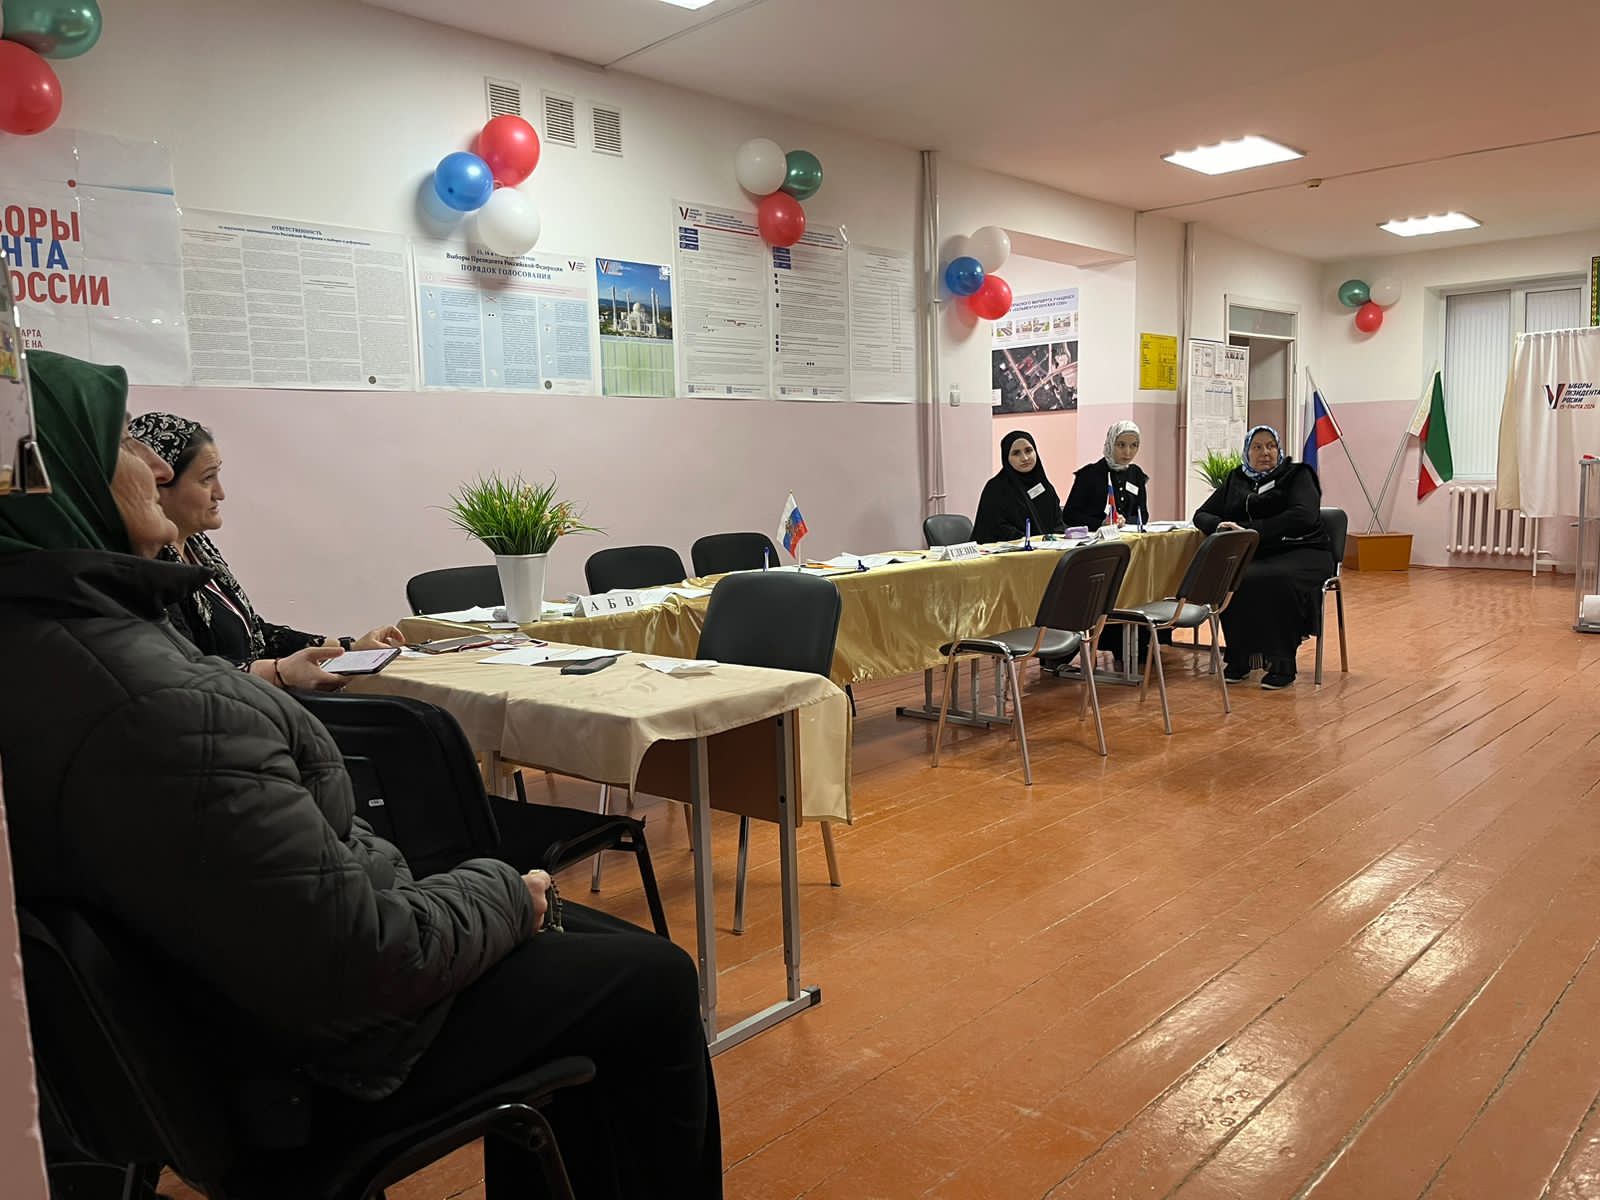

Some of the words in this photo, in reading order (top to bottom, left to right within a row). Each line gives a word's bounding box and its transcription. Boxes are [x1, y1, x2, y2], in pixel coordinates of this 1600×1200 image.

[0, 204, 80, 242] ОРЫ
[446, 252, 470, 262] Выборы
[471, 255, 503, 264] Президента
[503, 259, 534, 268] Российской
[535, 263, 564, 272] Федерации
[461, 264, 496, 274] ПОРЯДОК
[498, 268, 551, 280] ГОЛОСОВАНИЯ
[607, 599, 616, 609] Б
[625, 596, 634, 606] В
